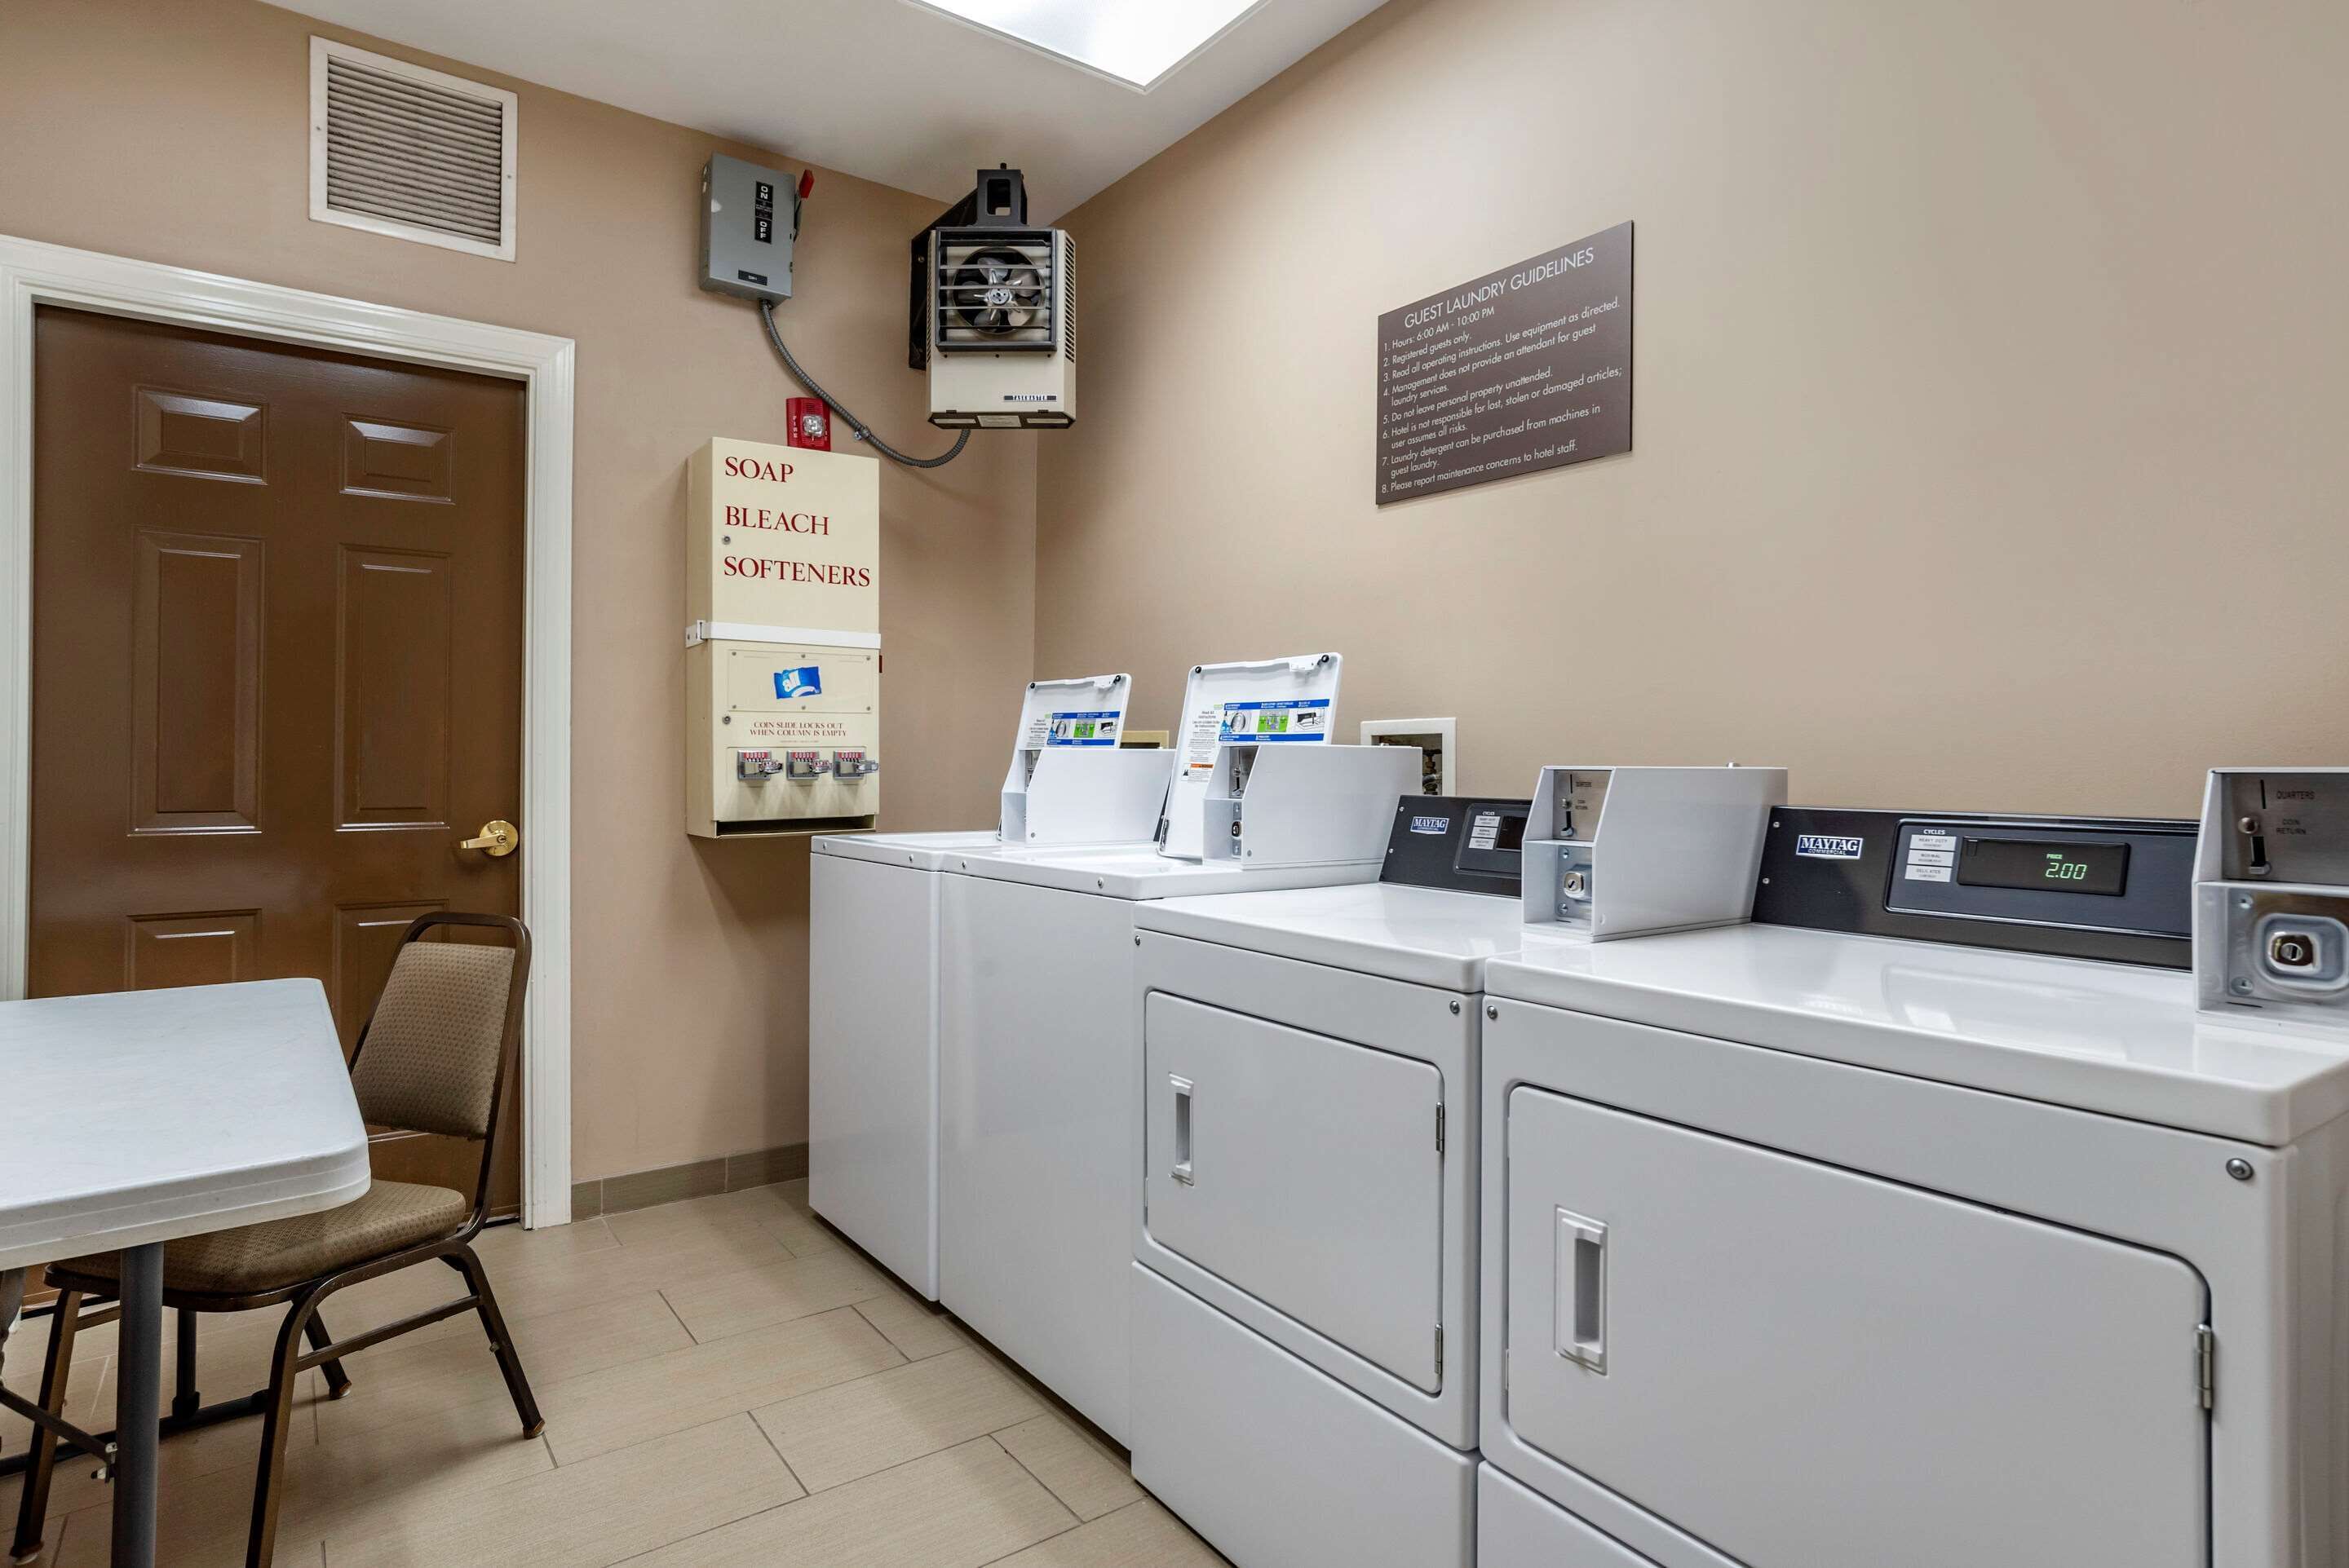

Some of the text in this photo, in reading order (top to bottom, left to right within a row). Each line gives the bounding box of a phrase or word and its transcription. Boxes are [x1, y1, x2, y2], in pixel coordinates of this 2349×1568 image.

[760, 186, 768, 199] ON
[1405, 247, 1594, 328] GUEST LAUNDRY GUIDELINES
[1383, 296, 1620, 382] 3. Read all operating instructions. Use equipment as directed.
[1384, 343, 1390, 352] 1.
[1392, 336, 1415, 349] Hours:
[1417, 328, 1434, 342] 6:00
[1436, 323, 1449, 334] AM
[1458, 311, 1480, 326] 10:00
[1482, 307, 1494, 319] PM
[1383, 330, 1471, 367] 2. Registered guests only.
[1383, 324, 1596, 396] 4. Management does not provide an attendant for guest
[1382, 366, 1622, 439] 6. Hotel is not responsible for lost, stolen or damaged articles;
[1383, 366, 1553, 424] 5. Do not leave personal property unattended.
[1391, 385, 1449, 406] laundry services.
[1382, 404, 1600, 466] 7. Laundry detergent can be purchased from machines in
[1391, 421, 1468, 448] user assumes all risks.
[725, 456, 794, 483] SOAP
[1382, 439, 1577, 493] 8. Please report maintenance concerns to hotel staff.
[1391, 457, 1440, 479] guest laundry.
[725, 506, 829, 535] BLEACH
[723, 556, 870, 587] SOFTENERS
[2276, 790, 2315, 799] QUARTERS
[1413, 819, 1446, 828] MAYTAG
[1801, 837, 1858, 851] MAYTAG
[2046, 863, 2087, 880] 2.00
